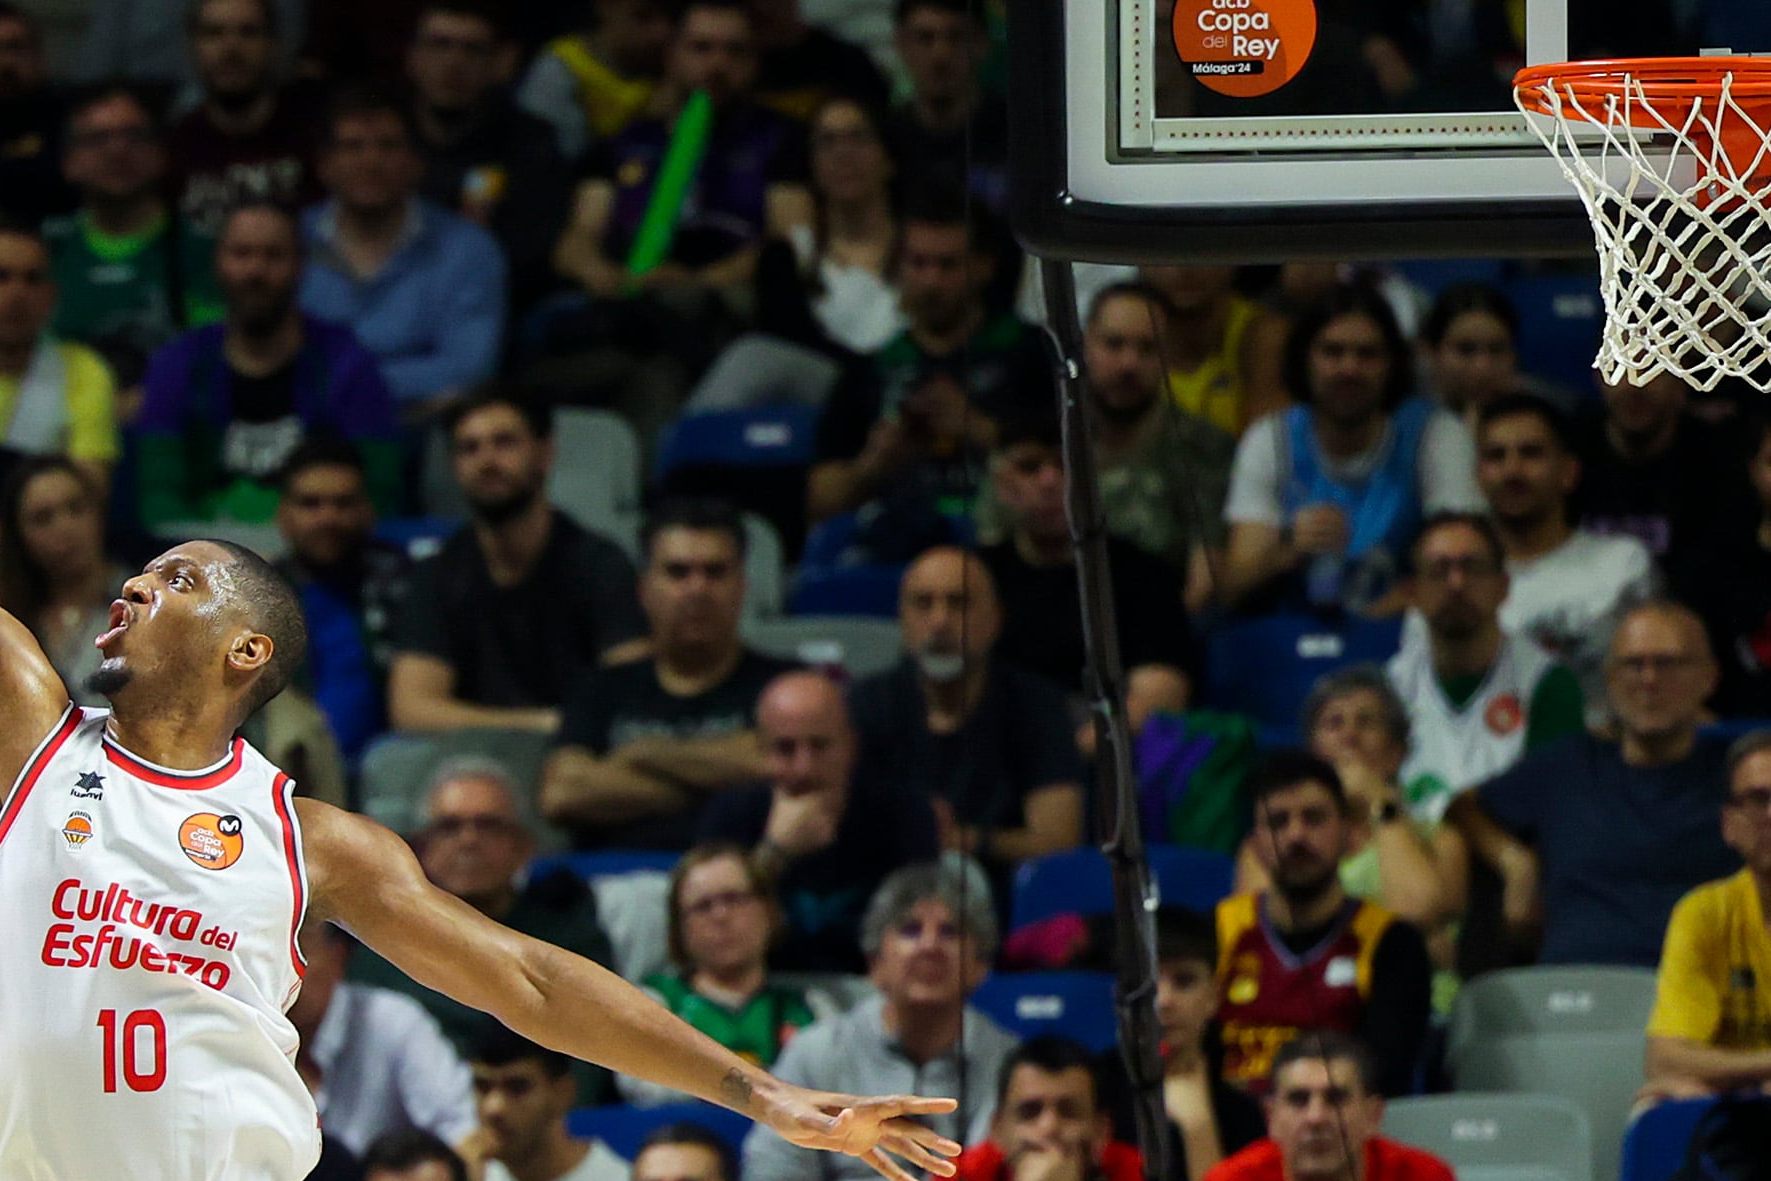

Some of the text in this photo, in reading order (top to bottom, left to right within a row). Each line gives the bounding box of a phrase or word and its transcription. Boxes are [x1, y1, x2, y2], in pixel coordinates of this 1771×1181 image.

[1197, 9, 1269, 34] Copa
[1202, 35, 1280, 60] del Rey
[189, 831, 222, 847] Copa
[51, 878, 238, 951] Cultura del
[41, 923, 231, 991] Esfuerzo
[97, 1008, 167, 1093] 10
